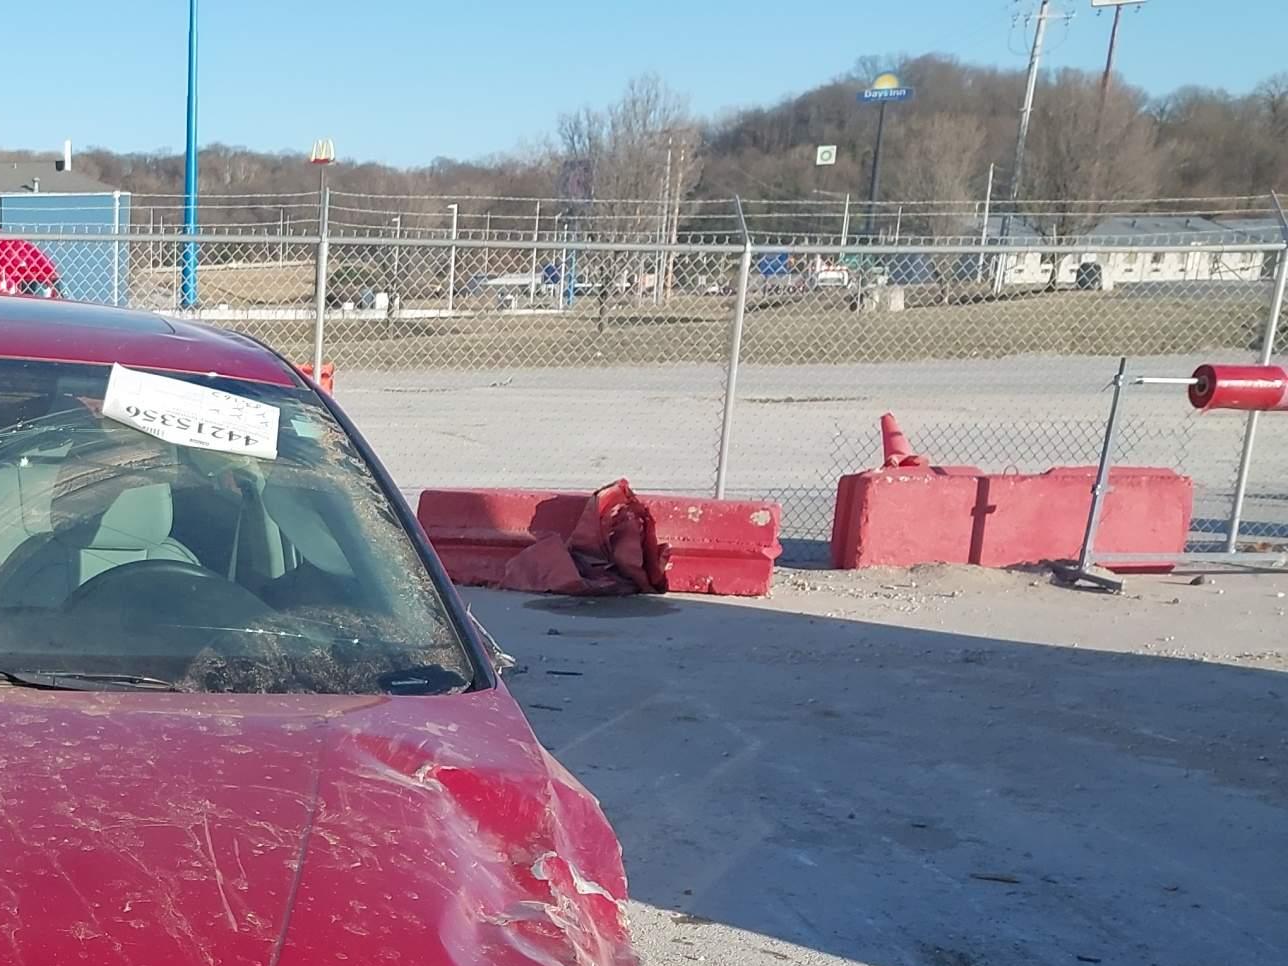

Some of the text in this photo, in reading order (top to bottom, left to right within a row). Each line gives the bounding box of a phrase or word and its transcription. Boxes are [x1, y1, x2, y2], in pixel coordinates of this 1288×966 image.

[864, 89, 906, 99] Days Inn
[126, 405, 259, 447] 44215356
